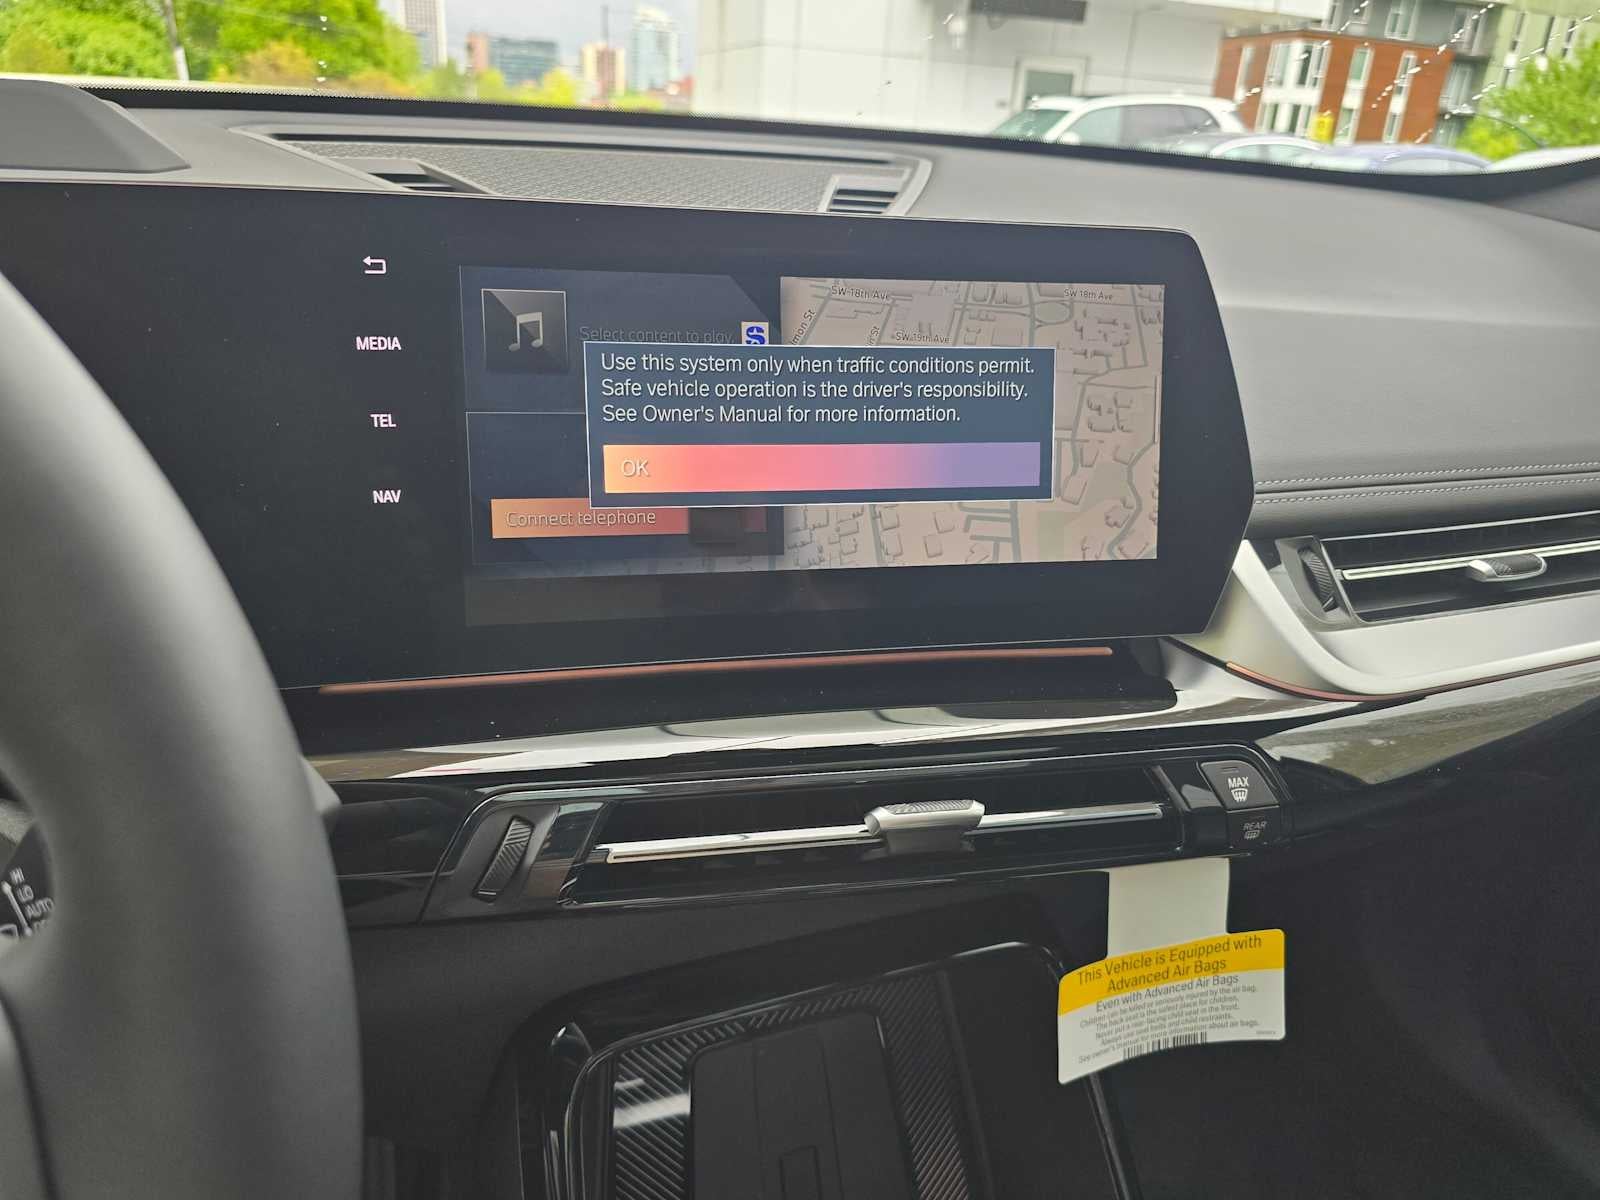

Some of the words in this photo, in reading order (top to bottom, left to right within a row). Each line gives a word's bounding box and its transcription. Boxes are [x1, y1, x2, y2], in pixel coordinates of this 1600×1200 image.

[831, 286, 848, 296] SW
[850, 288, 870, 299] 18th
[873, 290, 891, 300] Ave
[1064, 289, 1077, 297] SW
[1080, 291, 1097, 300] 18th
[1098, 292, 1113, 300] Ave
[804, 310, 815, 321] St
[356, 336, 401, 350] MEDIA
[579, 327, 624, 342] Select
[629, 328, 682, 343] content
[686, 329, 699, 343] to
[896, 332, 909, 341] SW
[912, 334, 930, 342] 19th
[932, 334, 950, 344] Ave
[601, 353, 636, 371] Use
[642, 353, 675, 371] this
[680, 355, 742, 375] system
[748, 357, 783, 376] only
[788, 356, 832, 373] when
[837, 357, 885, 374] traffic
[889, 357, 974, 374] conditions
[978, 358, 1035, 377] permit.
[602, 379, 642, 397] Safe
[647, 380, 710, 397] vehicle
[715, 382, 797, 401] operation
[803, 381, 816, 398] is
[820, 381, 848, 398] the
[853, 381, 913, 398] driver's
[917, 381, 1028, 401] responsibility.
[370, 414, 397, 428] TEL
[603, 405, 637, 422] See
[643, 405, 715, 422] Owner's
[720, 405, 782, 422] Manual
[787, 405, 811, 422] for
[815, 408, 858, 422] more
[863, 405, 961, 422] information.
[621, 460, 650, 477] OK
[373, 490, 401, 504] NAV
[506, 511, 574, 528] Connect
[577, 510, 657, 527] telephone
[1228, 777, 1249, 789] MAX
[1243, 821, 1268, 831] REAR
[25, 897, 55, 920] AUTO
[1078, 970, 1103, 986] This
[1104, 956, 1151, 976] Vehicle
[1155, 952, 1166, 964] is
[1170, 938, 1231, 964] Equipped
[1233, 935, 1262, 950] with
[1107, 970, 1170, 993] Advanced
[1173, 965, 1191, 979] Air
[1194, 958, 1228, 975] Bags
[1096, 998, 1120, 1013] Even
[1122, 991, 1142, 1004] with
[1144, 980, 1194, 1000] Advanced
[1197, 977, 1210, 988] Air
[1212, 974, 1240, 986] Bags
